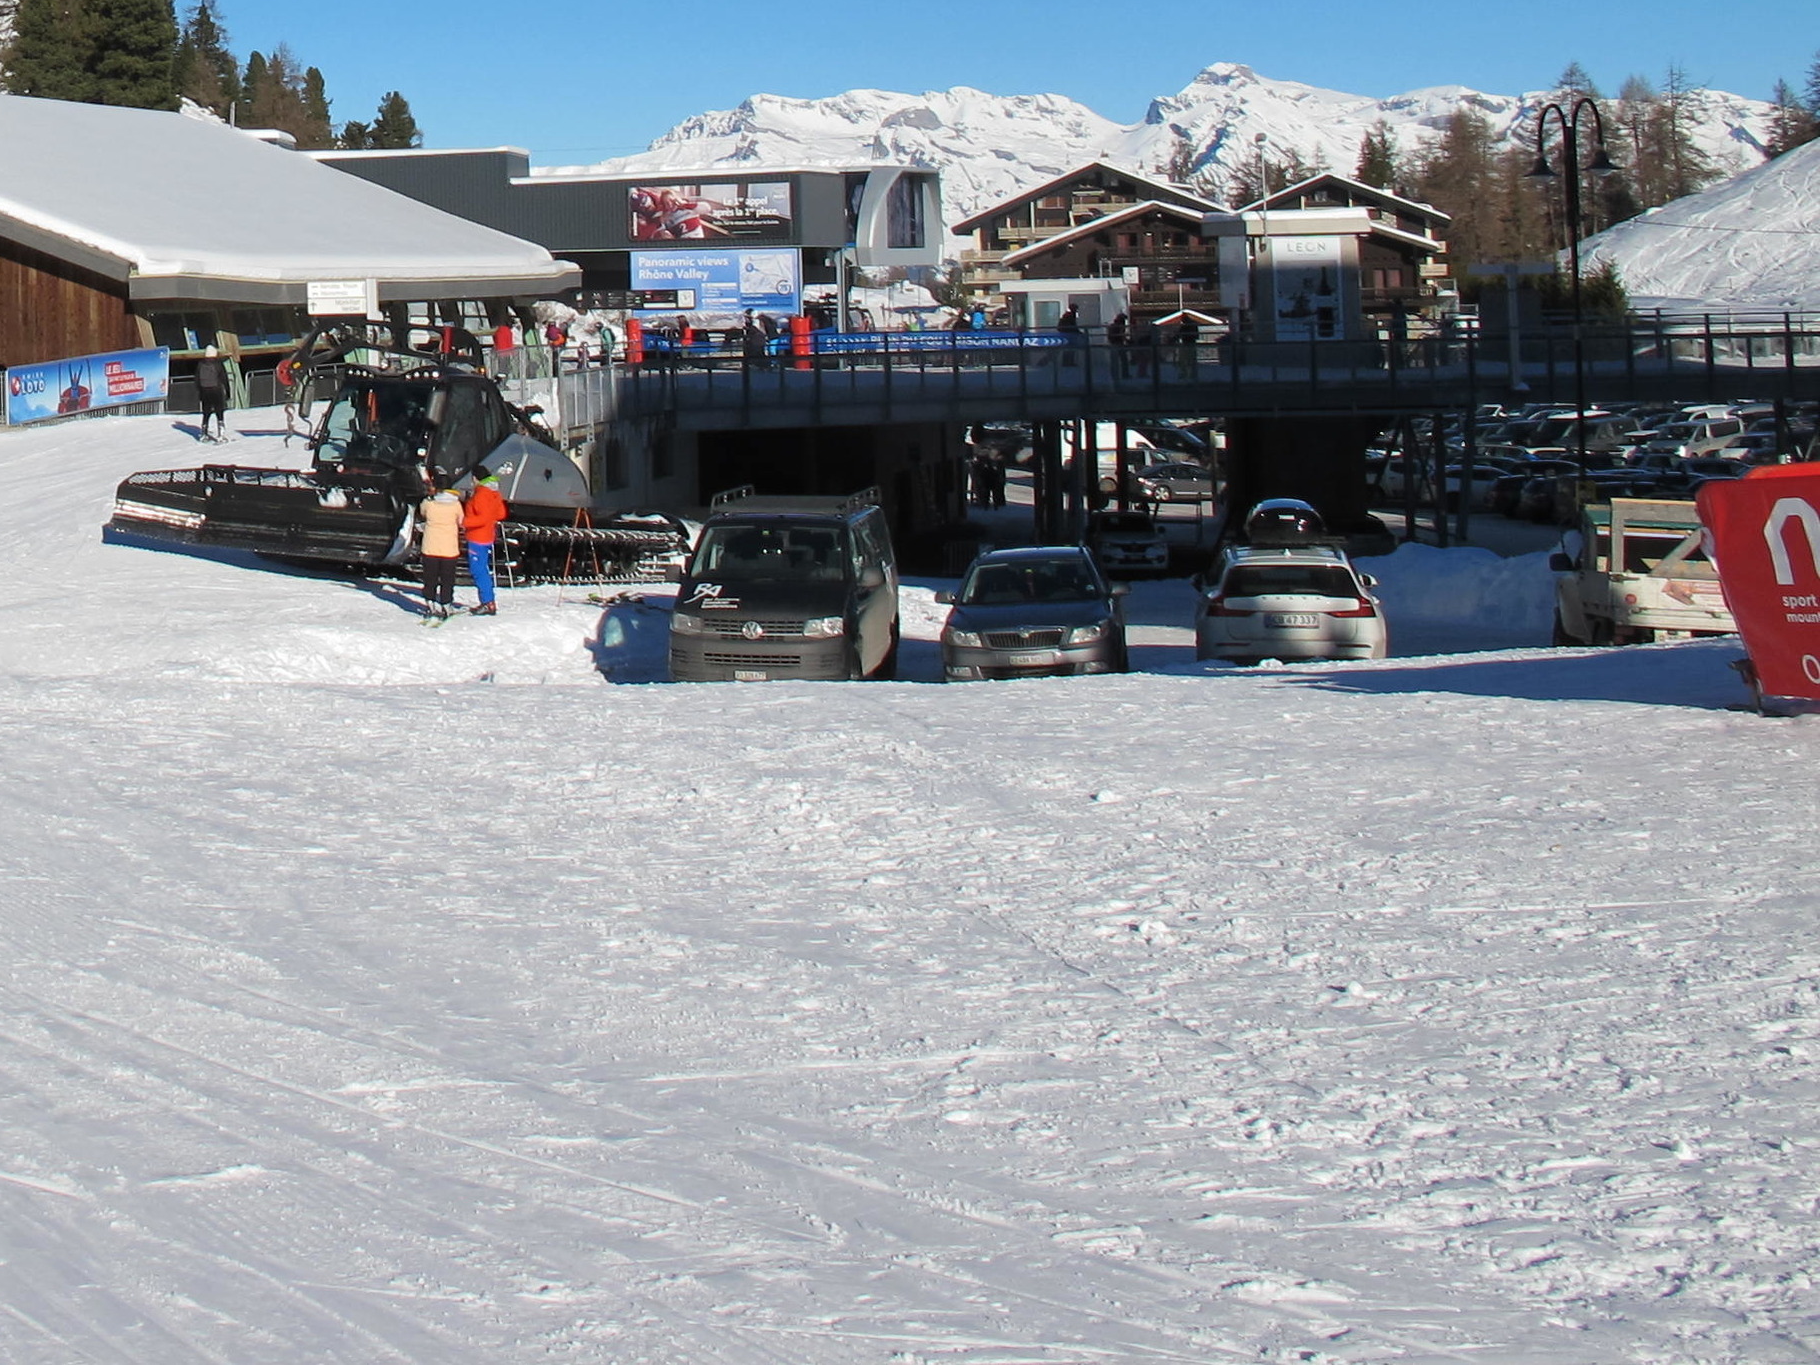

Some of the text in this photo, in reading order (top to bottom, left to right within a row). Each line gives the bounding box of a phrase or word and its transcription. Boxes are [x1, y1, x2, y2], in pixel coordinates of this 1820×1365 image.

[638, 256, 729, 267] Panoramic views
[638, 268, 710, 281] Rhône Valley
[21, 379, 46, 395] LOTO
[1782, 594, 1818, 609] sport
